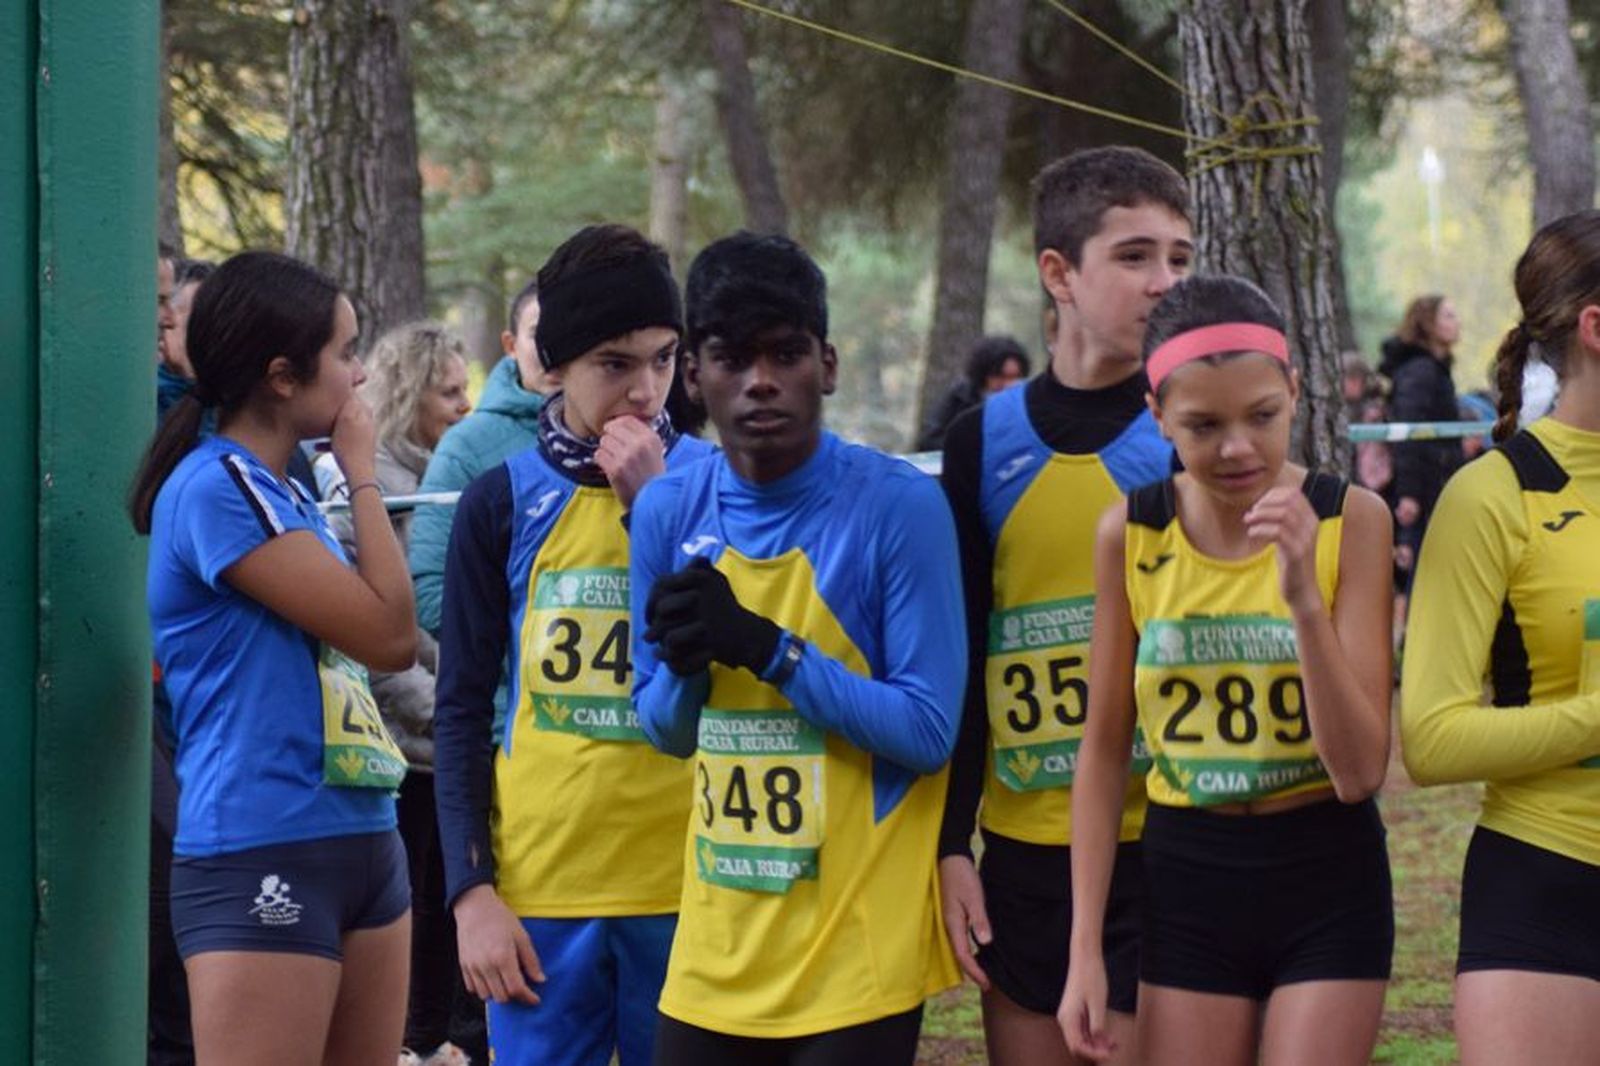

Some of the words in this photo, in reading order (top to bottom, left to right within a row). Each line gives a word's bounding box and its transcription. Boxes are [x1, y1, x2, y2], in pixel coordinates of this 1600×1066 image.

[582, 590, 623, 606] CAJA
[541, 617, 633, 685] 34
[1192, 640, 1239, 661] CAJA
[1003, 656, 1090, 733] 35
[573, 707, 620, 726] CAJA
[1158, 674, 1312, 745] 289
[703, 735, 736, 751] CAJA
[740, 735, 800, 751] RURAL
[1195, 770, 1251, 794] CAJA
[698, 760, 803, 835] 348
[716, 856, 753, 876] CAJA
